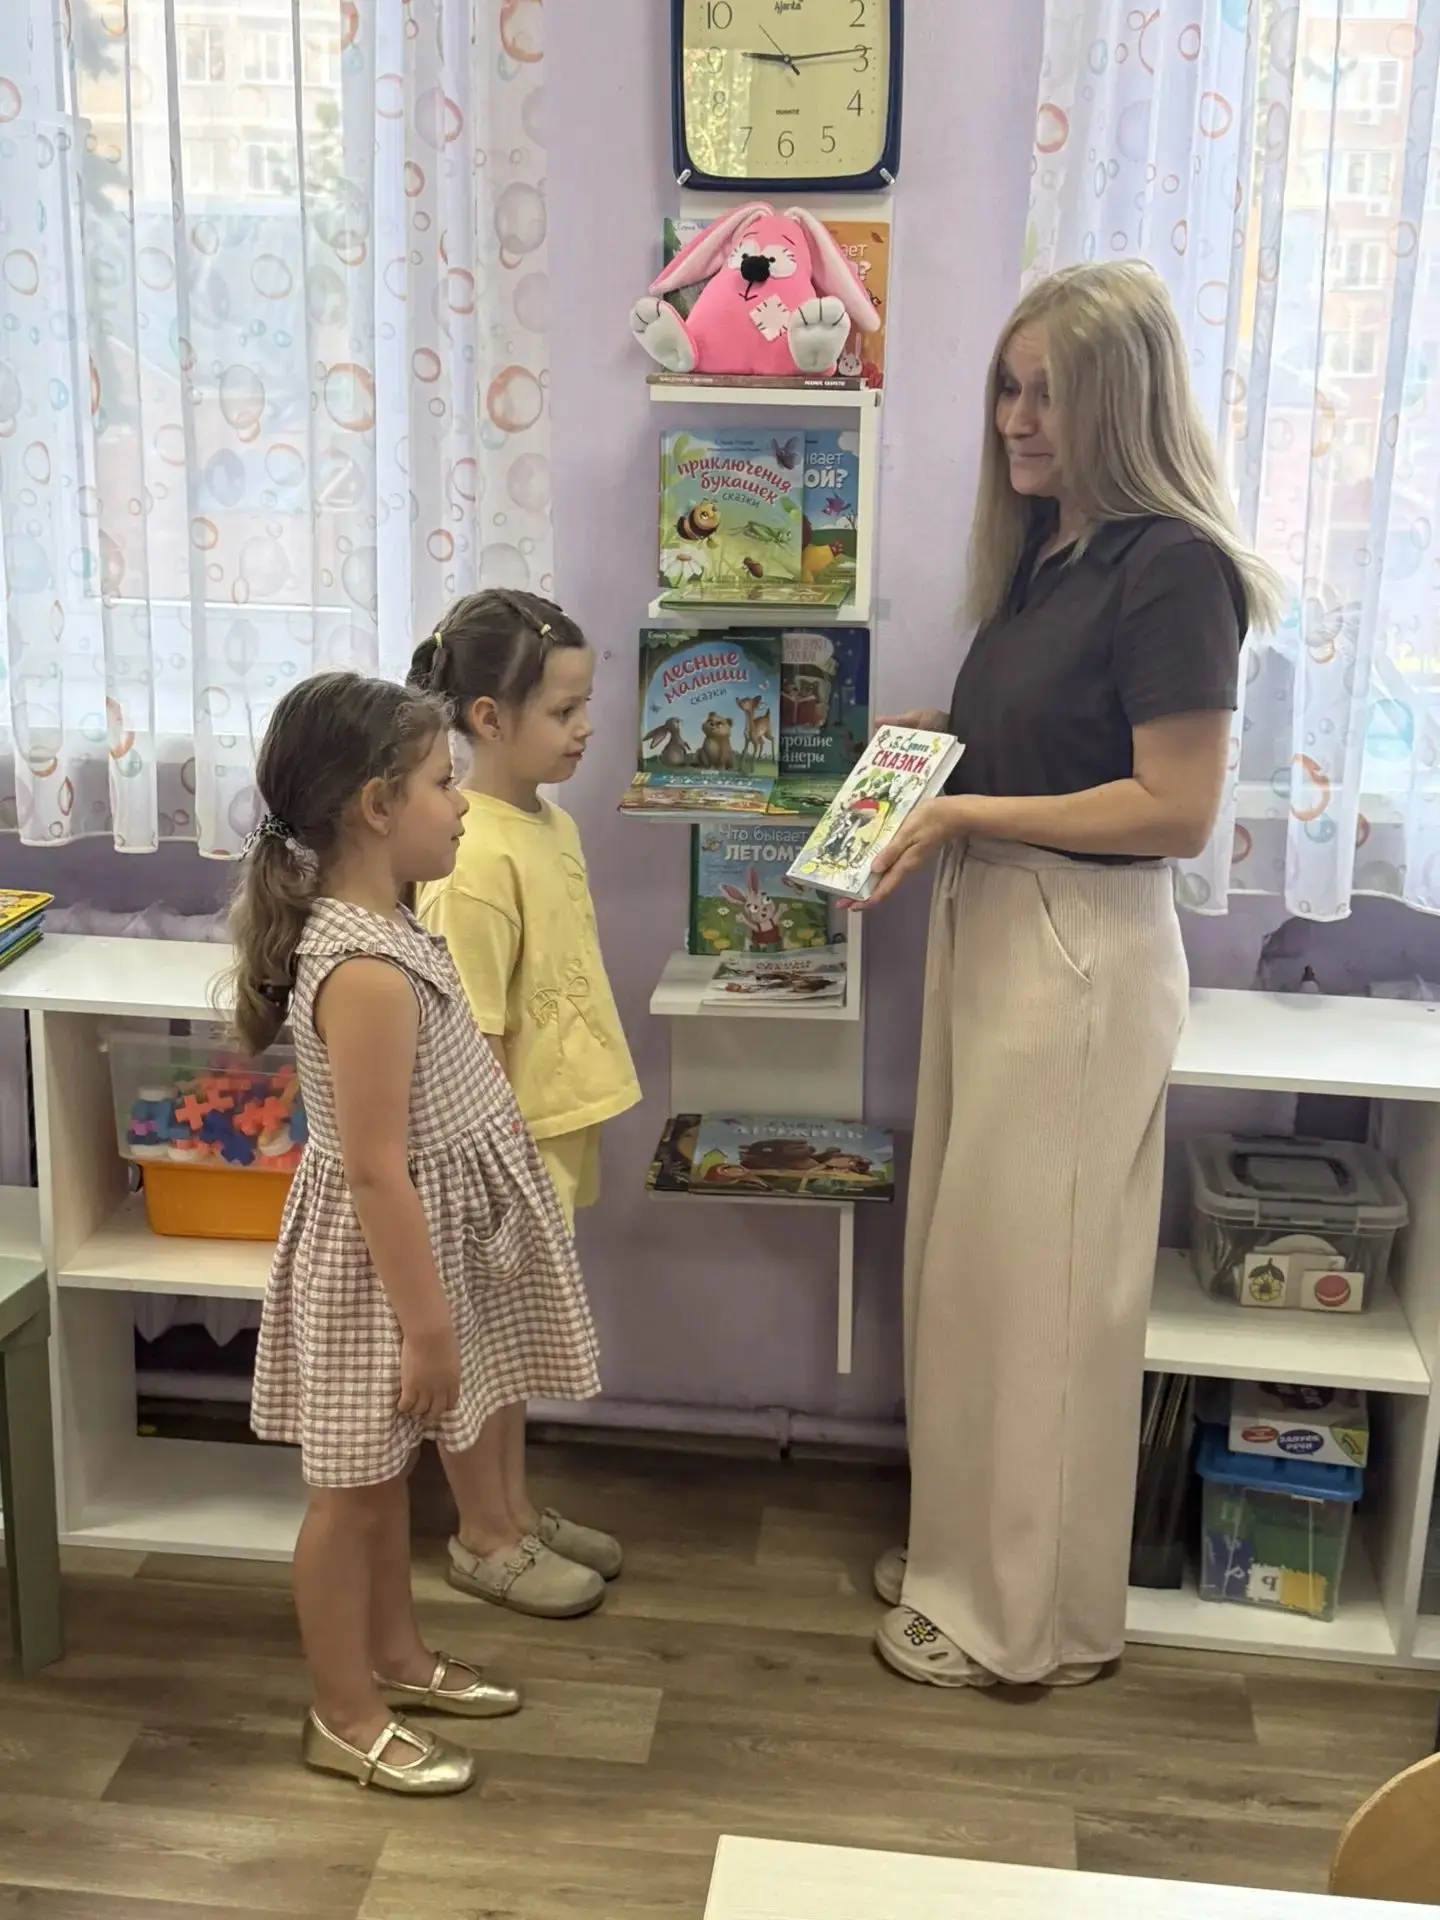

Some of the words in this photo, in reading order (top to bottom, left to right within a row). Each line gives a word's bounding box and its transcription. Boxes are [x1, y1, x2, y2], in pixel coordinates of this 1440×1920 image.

[706, 0, 733, 29] 10
[849, 0, 865, 27] 2
[707, 46, 723, 74] 9
[852, 44, 869, 73] 3
[712, 90, 727, 118] 8
[846, 89, 863, 117] 4
[739, 126, 753, 153] 7
[777, 130, 795, 158] 6
[820, 125, 836, 153] 5
[782, 751, 825, 769] анеры
[871, 749, 930, 774] СКАЗКИ
[753, 825, 809, 842] бывает
